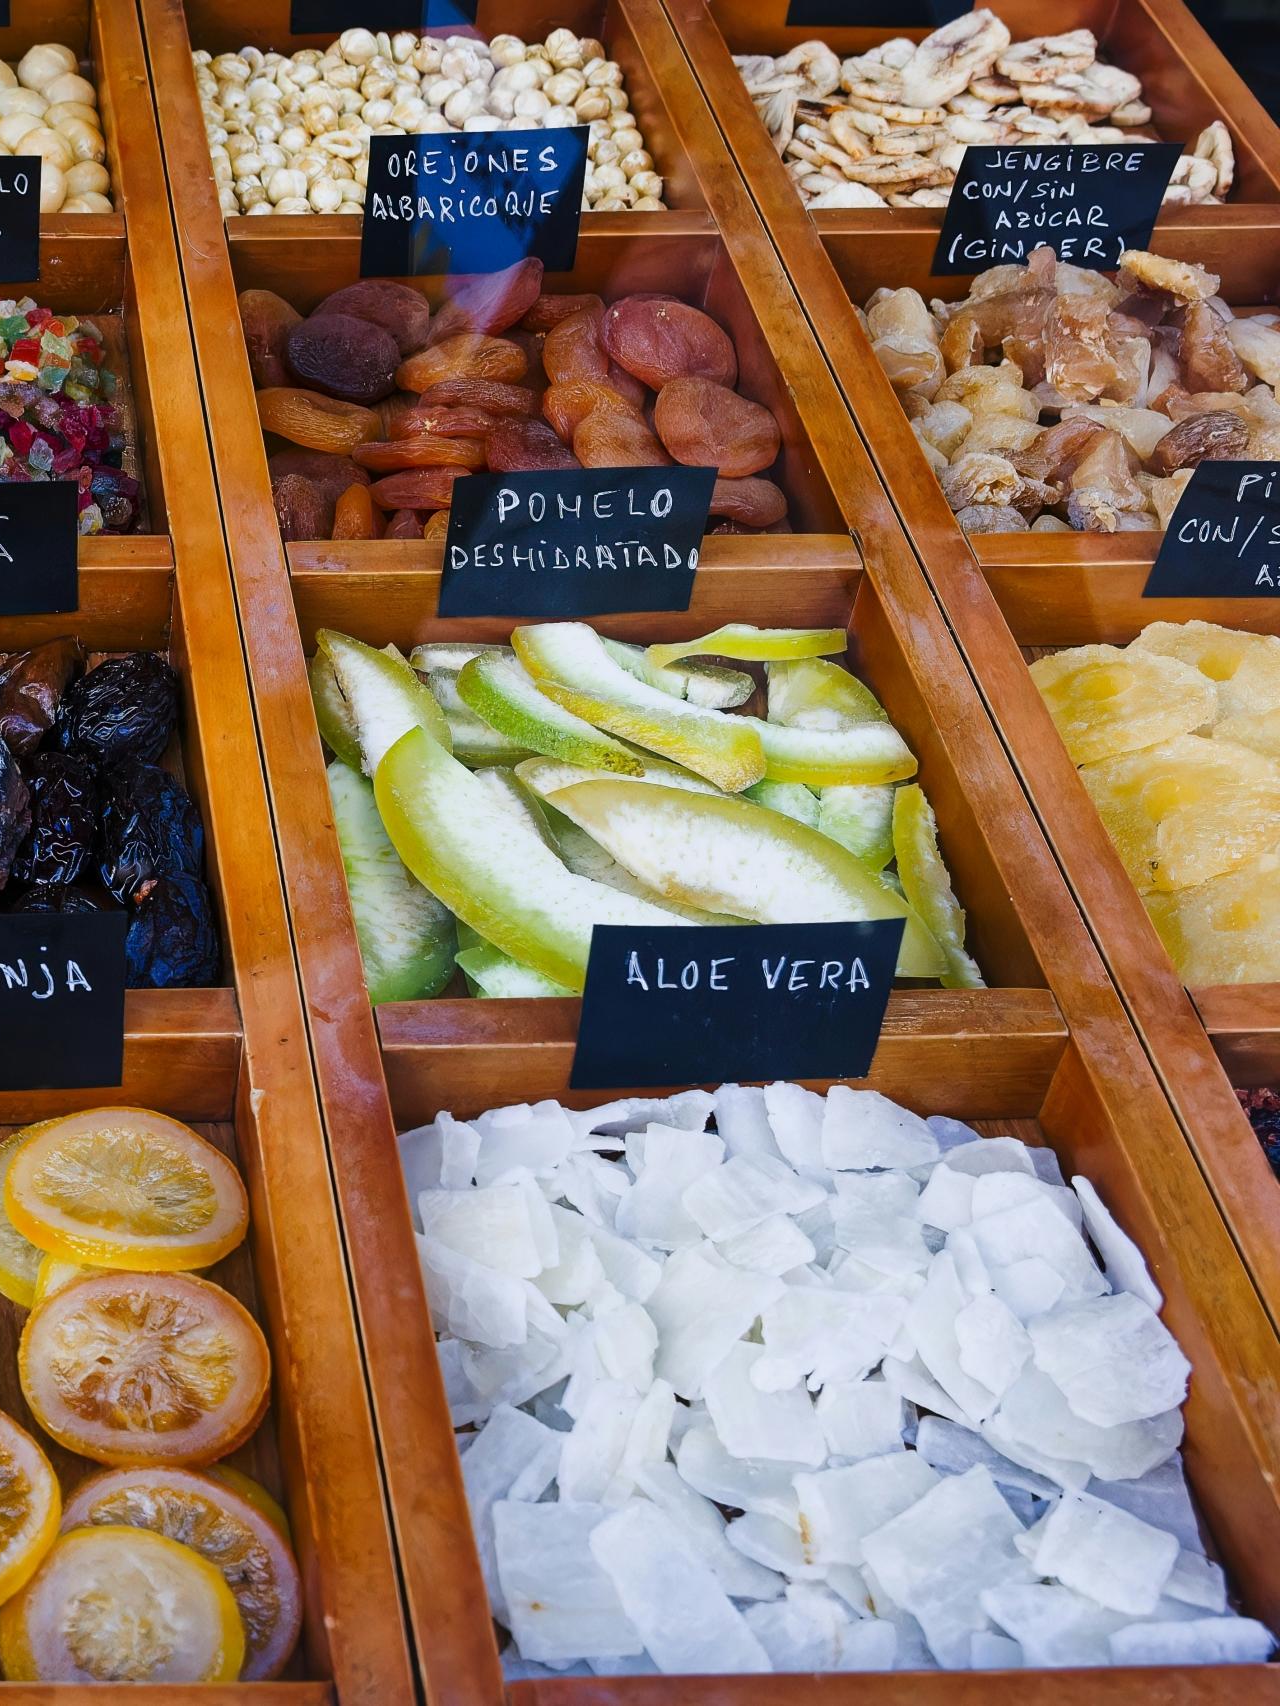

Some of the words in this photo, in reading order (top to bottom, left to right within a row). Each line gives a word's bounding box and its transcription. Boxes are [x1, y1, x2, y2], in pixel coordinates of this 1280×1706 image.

[497, 488, 673, 523] POMELO
[627, 951, 736, 991] ALOE
[762, 956, 871, 993] VERA
